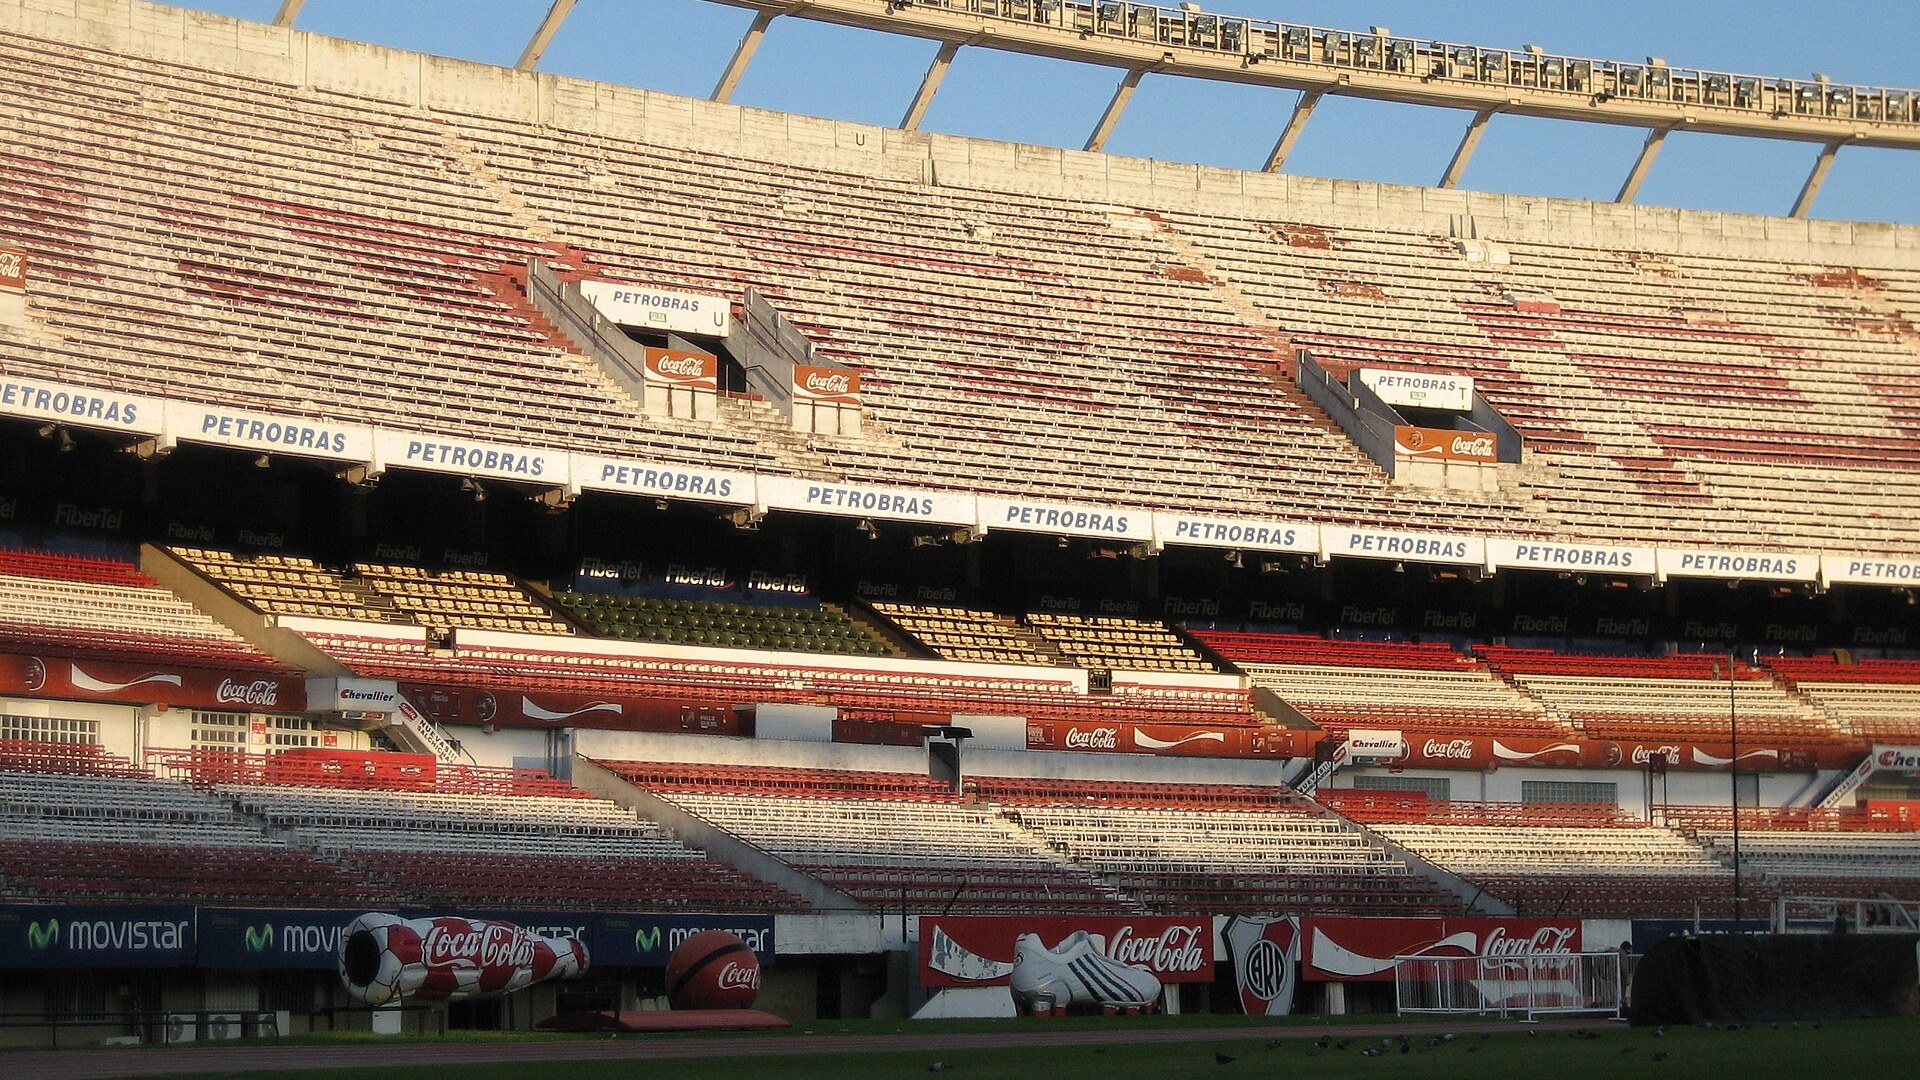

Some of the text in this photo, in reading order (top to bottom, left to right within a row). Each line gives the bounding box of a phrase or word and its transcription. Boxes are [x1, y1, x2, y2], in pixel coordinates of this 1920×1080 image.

[855, 133, 865, 146] U
[1525, 203, 1533, 215] T
[614, 290, 699, 312] PETROBRAS
[714, 312, 724, 327] U
[657, 355, 705, 377] Coca-Cola
[806, 372, 850, 393] Coca-Cola
[1378, 376, 1456, 391] PETROBRAS
[1459, 387, 1467, 400] T
[0, 383, 137, 424] ETROBRAS
[202, 414, 346, 453] PETROBRAS
[1451, 436, 1494, 457] Coca-Cola
[407, 441, 544, 476] PETROBRAS
[601, 465, 731, 497] PETROBRAS
[807, 487, 933, 516] PETROBRAS
[1006, 506, 1128, 533] PETROBRAS
[1175, 521, 1296, 546] PETROBRAS
[1350, 534, 1467, 557] PETROBRAS
[1515, 545, 1632, 567] PETROBRAS
[579, 557, 643, 580] FiberTel
[1681, 554, 1797, 574] PETROBRAS
[665, 564, 726, 587] FiberTel
[747, 570, 806, 592] FiberTel
[216, 678, 280, 706] Coca-Cola
[340, 689, 394, 701] Chevallier
[1066, 727, 1117, 748] Coca-Cola
[1352, 740, 1398, 748] Chevallier
[1423, 738, 1473, 760] Coca-Cola
[422, 926, 534, 968] Coca-Cola
